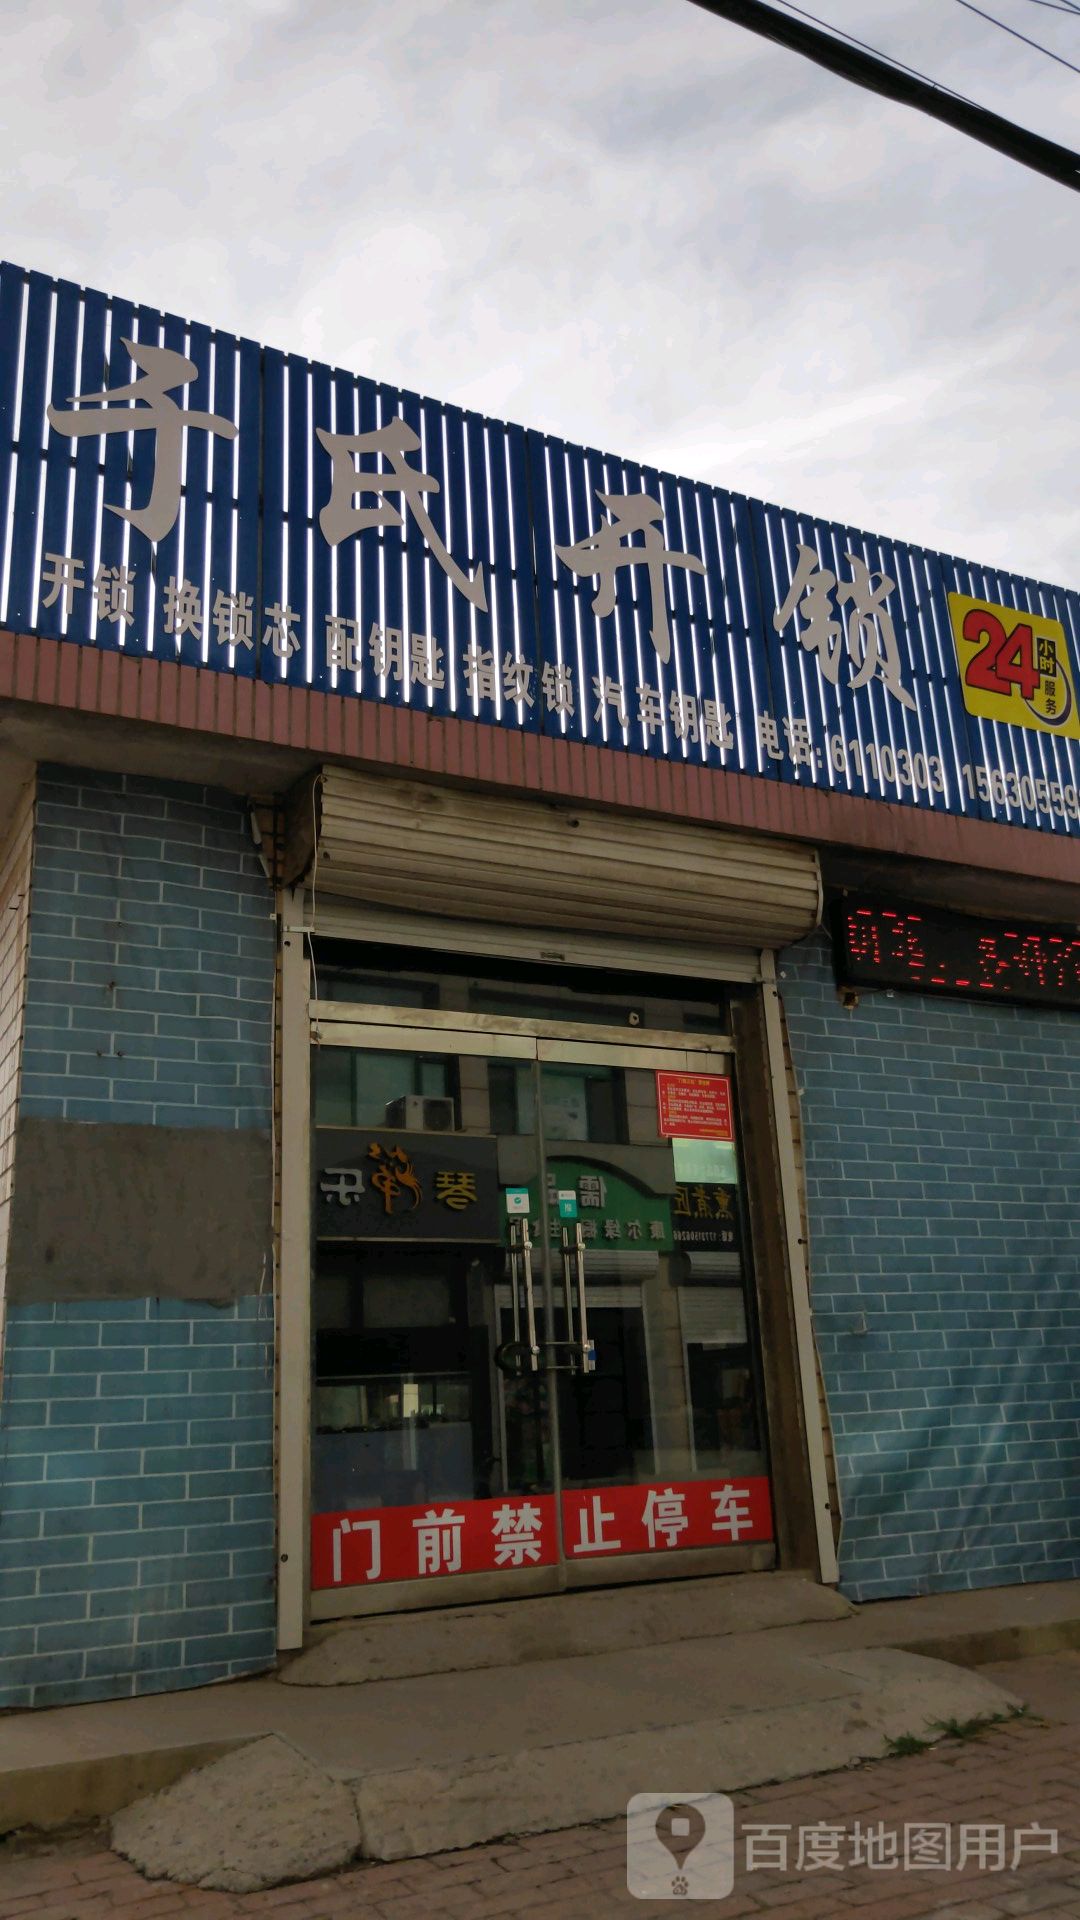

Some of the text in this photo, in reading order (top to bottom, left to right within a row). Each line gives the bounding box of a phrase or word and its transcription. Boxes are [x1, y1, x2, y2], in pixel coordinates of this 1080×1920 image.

[42, 551, 135, 627] 开锁
[163, 575, 301, 659] 换锁芯
[325, 614, 446, 690] 配钥匙
[463, 643, 575, 718] 指纹锁
[592, 675, 734, 750] 汽车钥匙
[961, 763, 1080, 820] 15630559
[962, 608, 1040, 700] 24
[332, 1484, 753, 1583] 门前禁止停车
